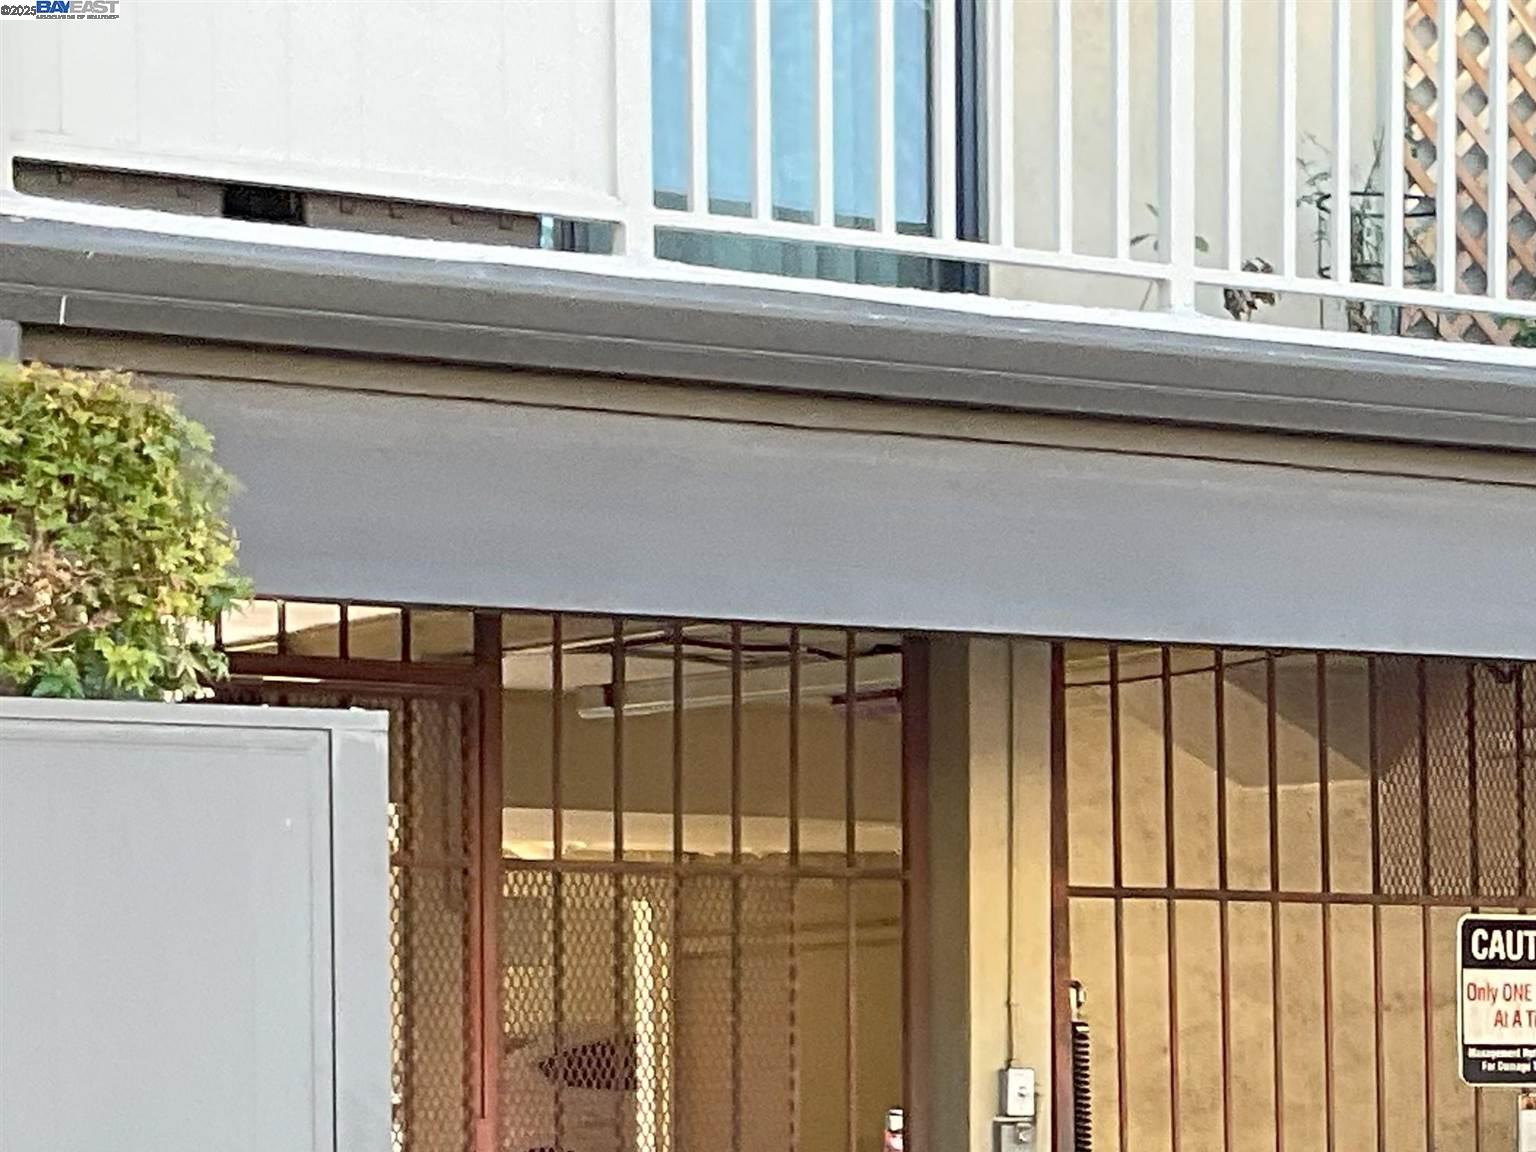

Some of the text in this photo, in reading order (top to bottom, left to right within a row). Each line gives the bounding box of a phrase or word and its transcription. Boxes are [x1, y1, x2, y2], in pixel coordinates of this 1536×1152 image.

[1467, 983, 1498, 1004] Only
[1503, 983, 1532, 1001] ONE
[1494, 1010, 1508, 1027] At
[1512, 1010, 1522, 1027] A
